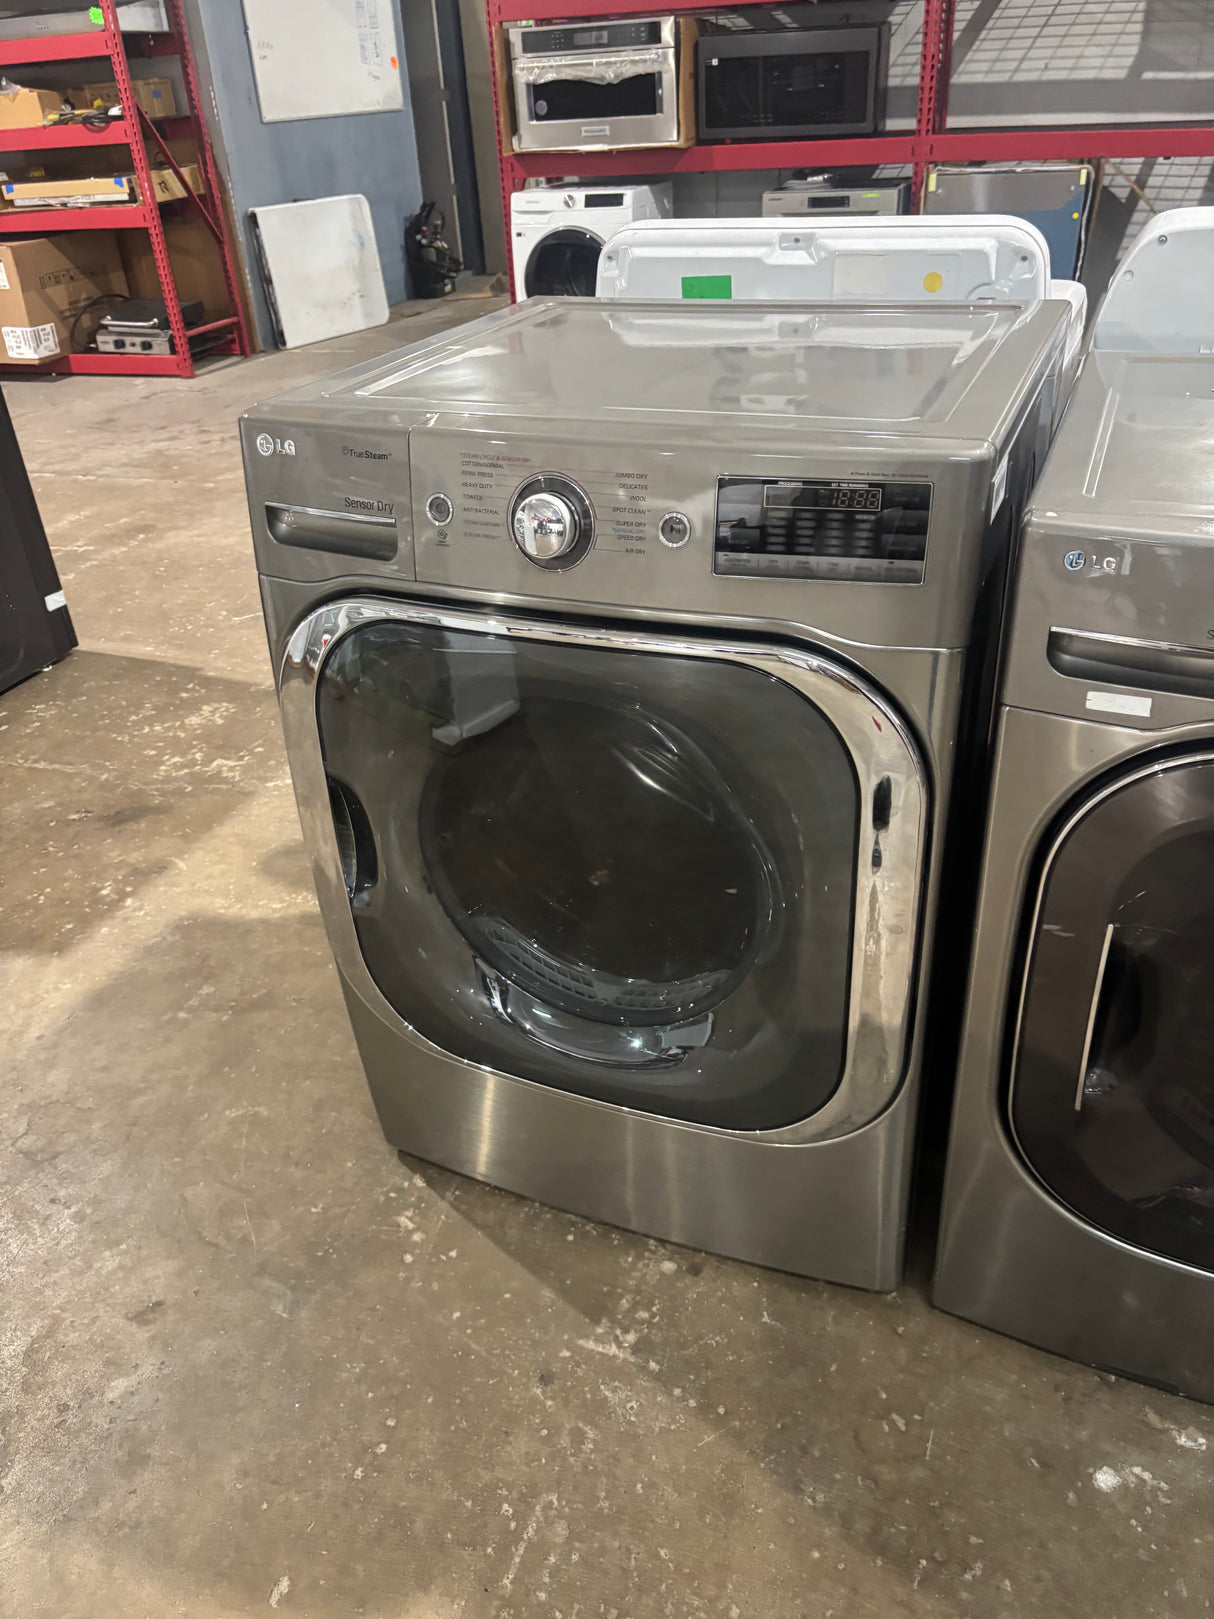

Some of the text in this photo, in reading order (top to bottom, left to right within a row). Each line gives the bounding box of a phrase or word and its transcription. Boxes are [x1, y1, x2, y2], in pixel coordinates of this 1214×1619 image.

[275, 438, 296, 456] LG
[618, 482, 649, 491] DELICATES
[463, 493, 483, 501] TOWELS
[344, 496, 395, 515] Sensor Dry
[1091, 555, 1117, 570] LG
